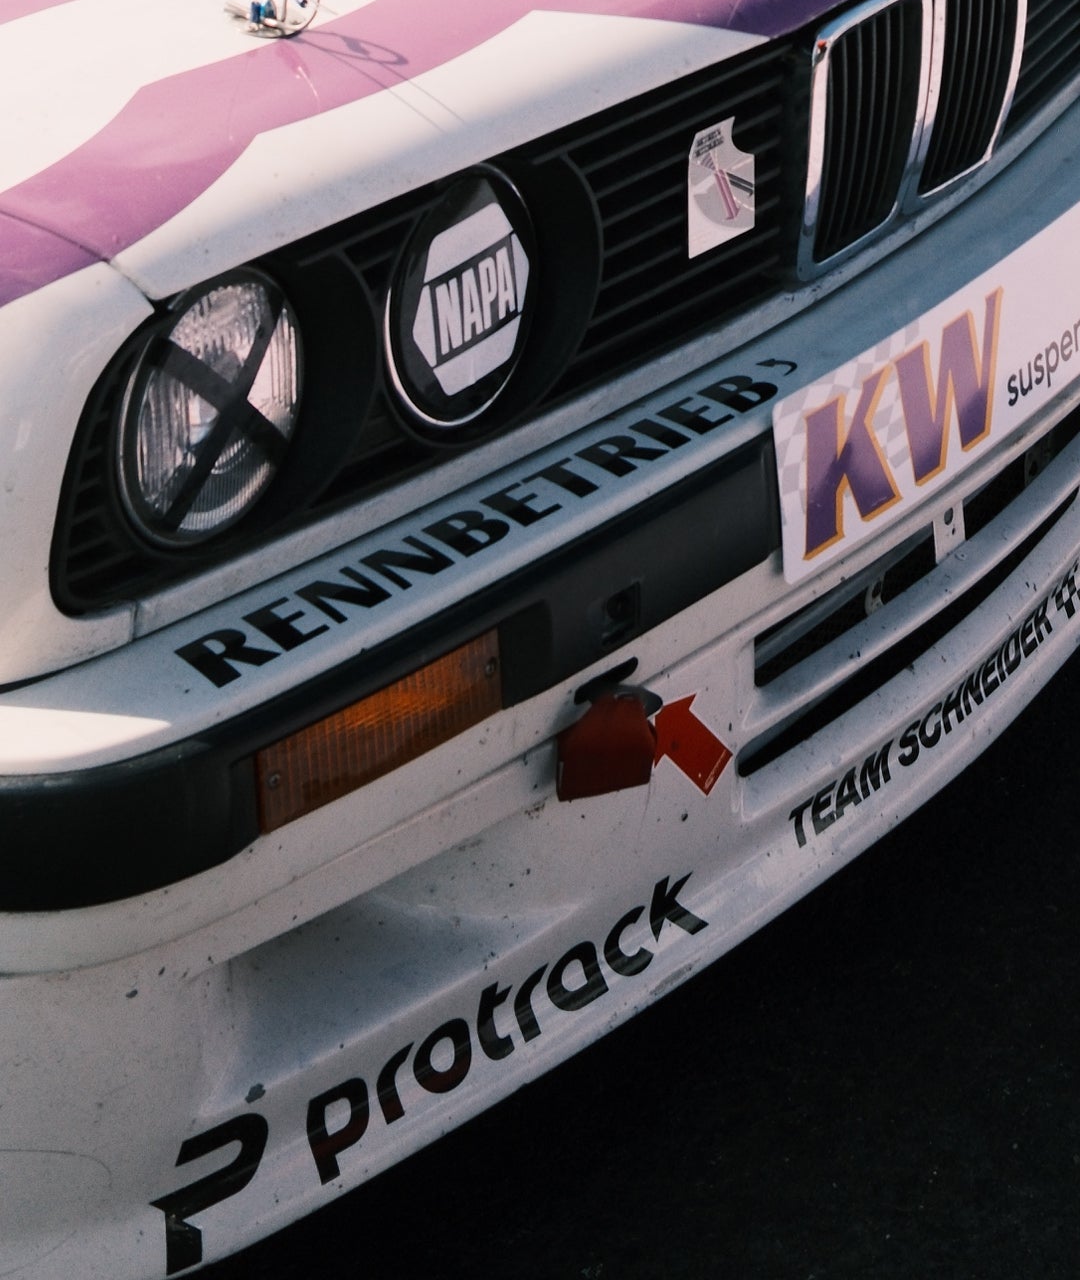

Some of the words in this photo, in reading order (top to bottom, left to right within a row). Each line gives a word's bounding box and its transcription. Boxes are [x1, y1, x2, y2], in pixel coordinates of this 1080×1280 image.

[436, 246, 515, 356] NAPA
[803, 286, 1004, 561] KW
[789, 739, 894, 848] TEAM
[898, 596, 1053, 767] SCHNEIDER
[307, 872, 708, 1186] protrack
